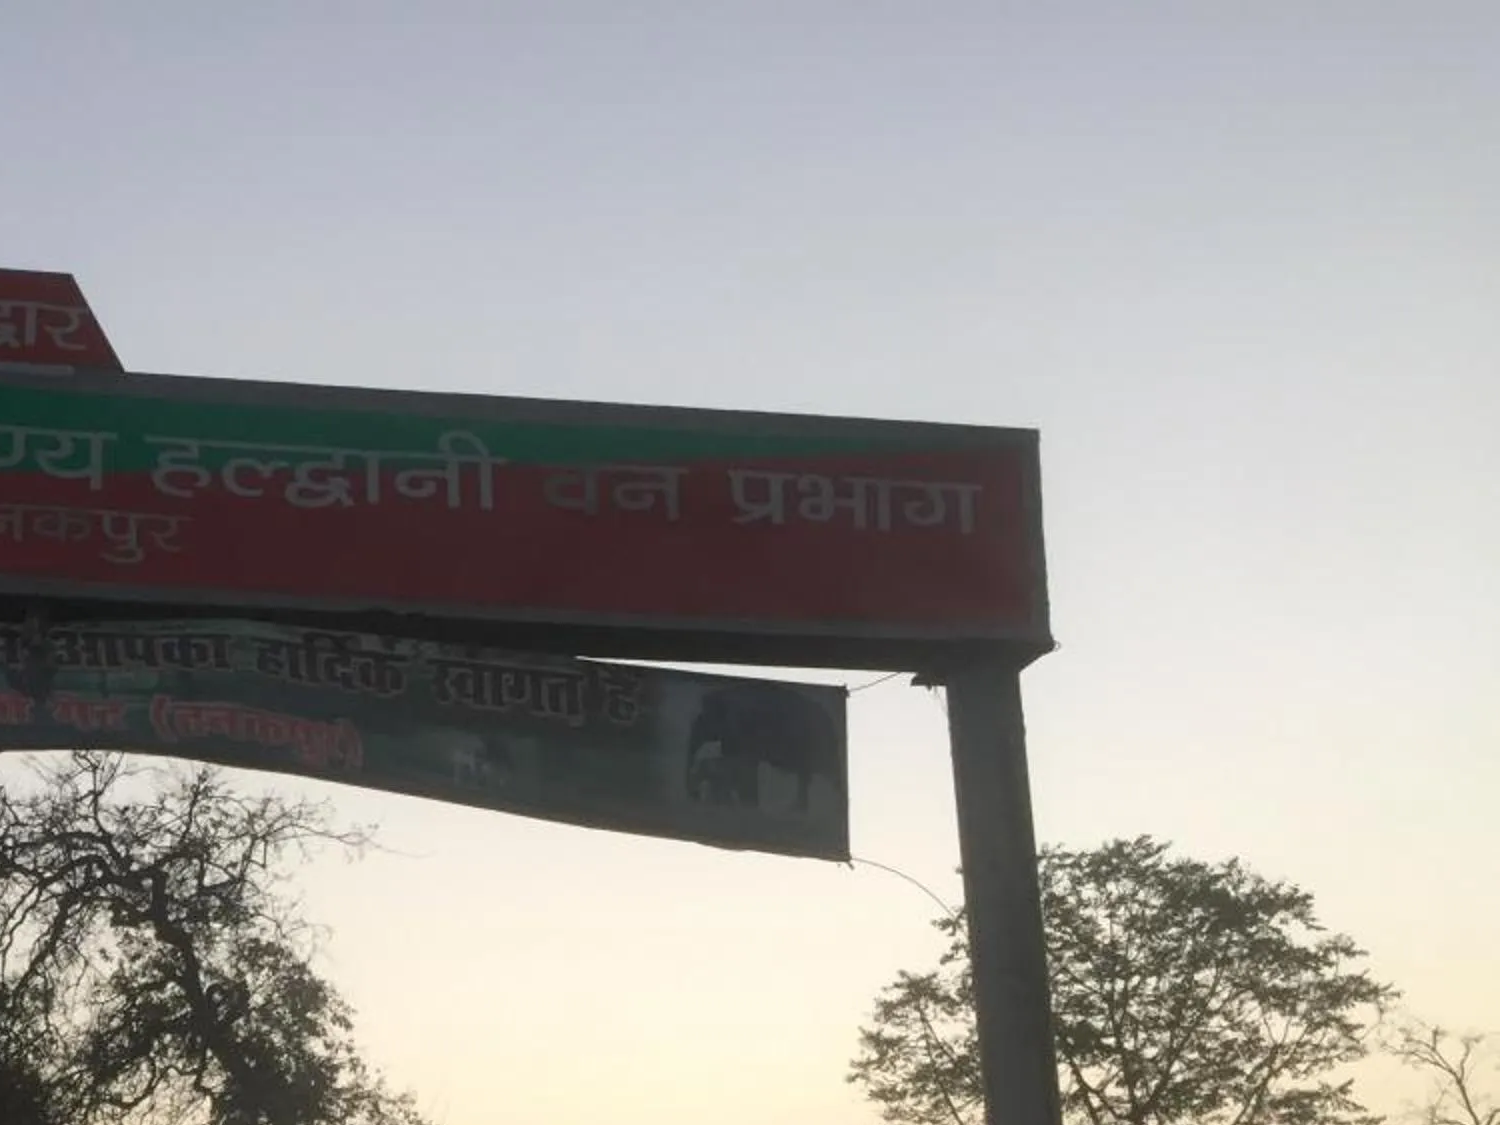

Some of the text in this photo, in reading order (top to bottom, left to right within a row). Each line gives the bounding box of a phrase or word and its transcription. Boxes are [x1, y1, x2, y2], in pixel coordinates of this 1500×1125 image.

[145, 430, 508, 511] हल्द्वानी
[543, 460, 688, 523] वन
[727, 466, 983, 535] प्रभाग
